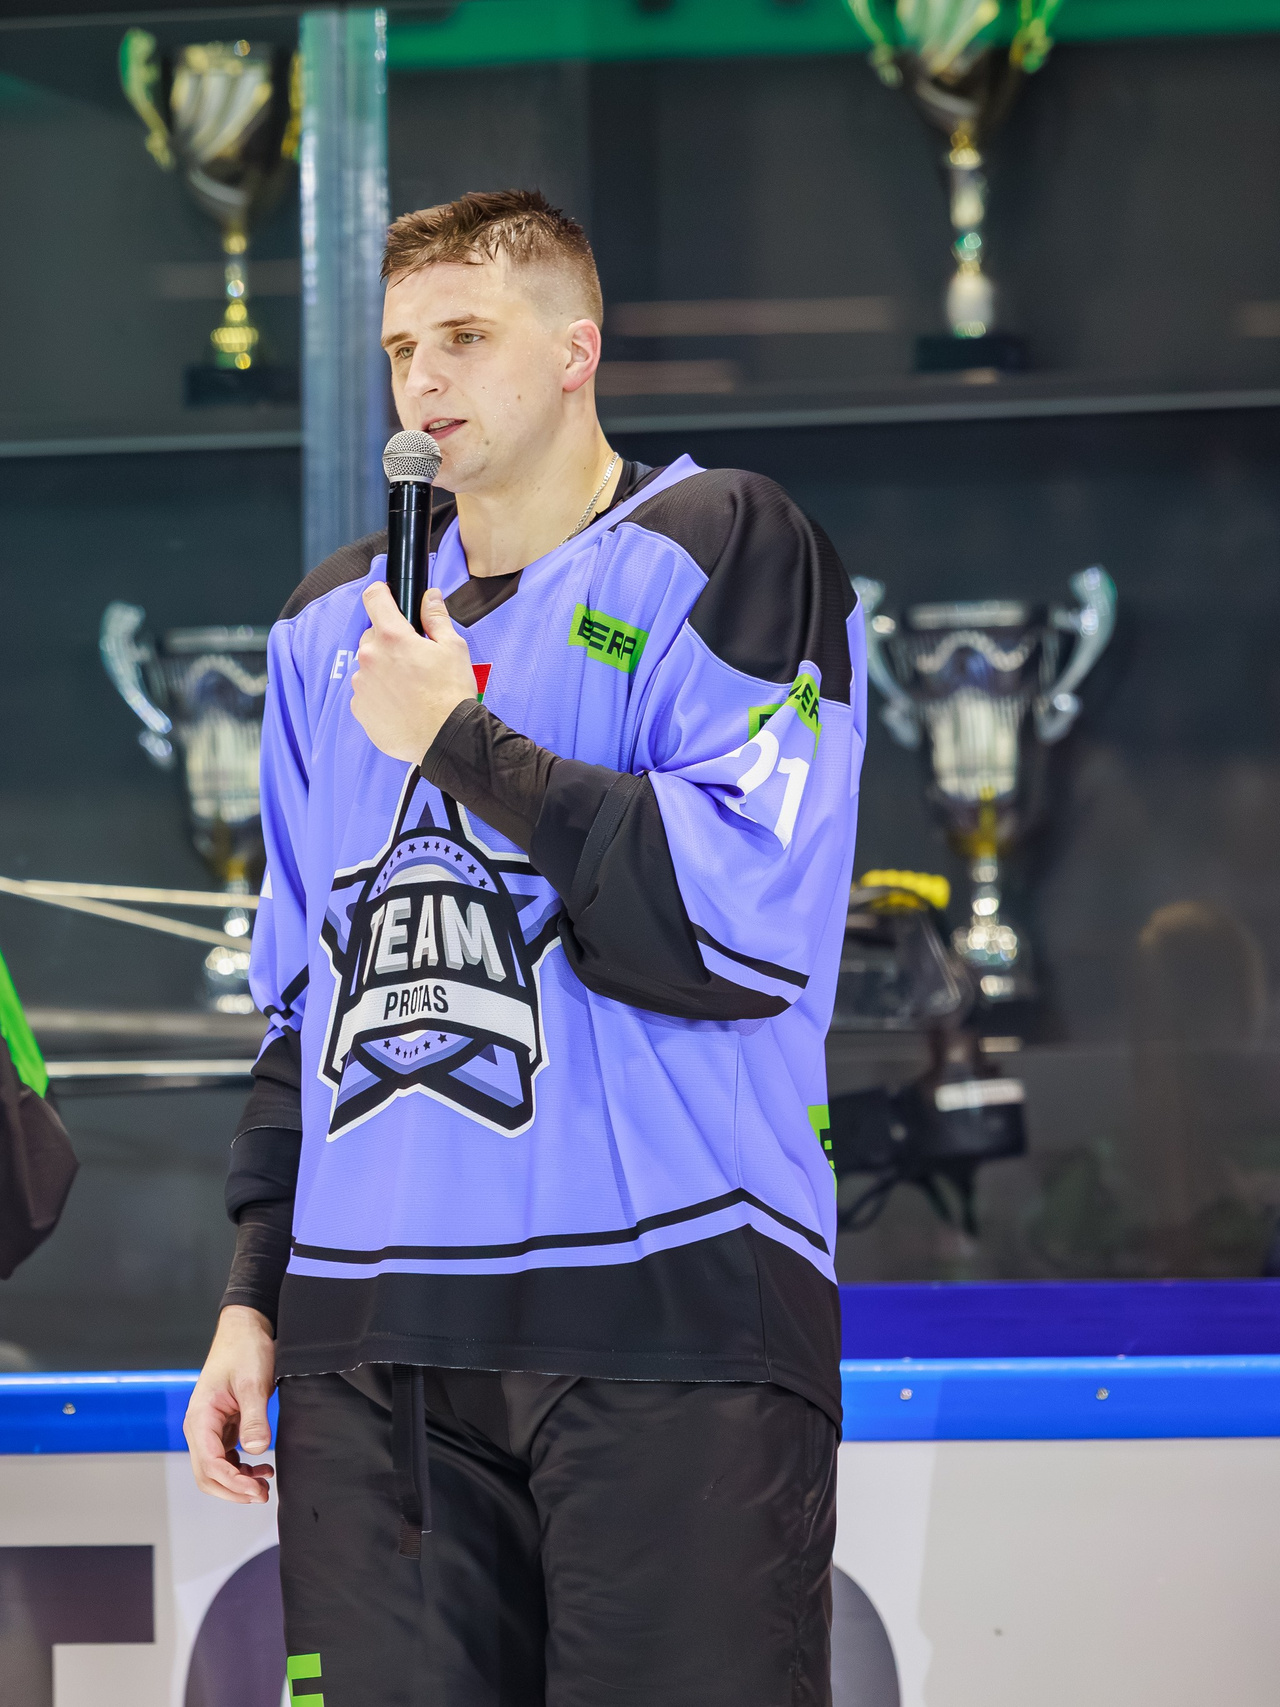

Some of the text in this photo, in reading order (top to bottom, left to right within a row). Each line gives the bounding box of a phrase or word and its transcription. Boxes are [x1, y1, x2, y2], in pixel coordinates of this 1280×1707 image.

[721, 729, 810, 851] 21
[362, 894, 506, 985] TEAM
[383, 984, 449, 1020] PROTAS
